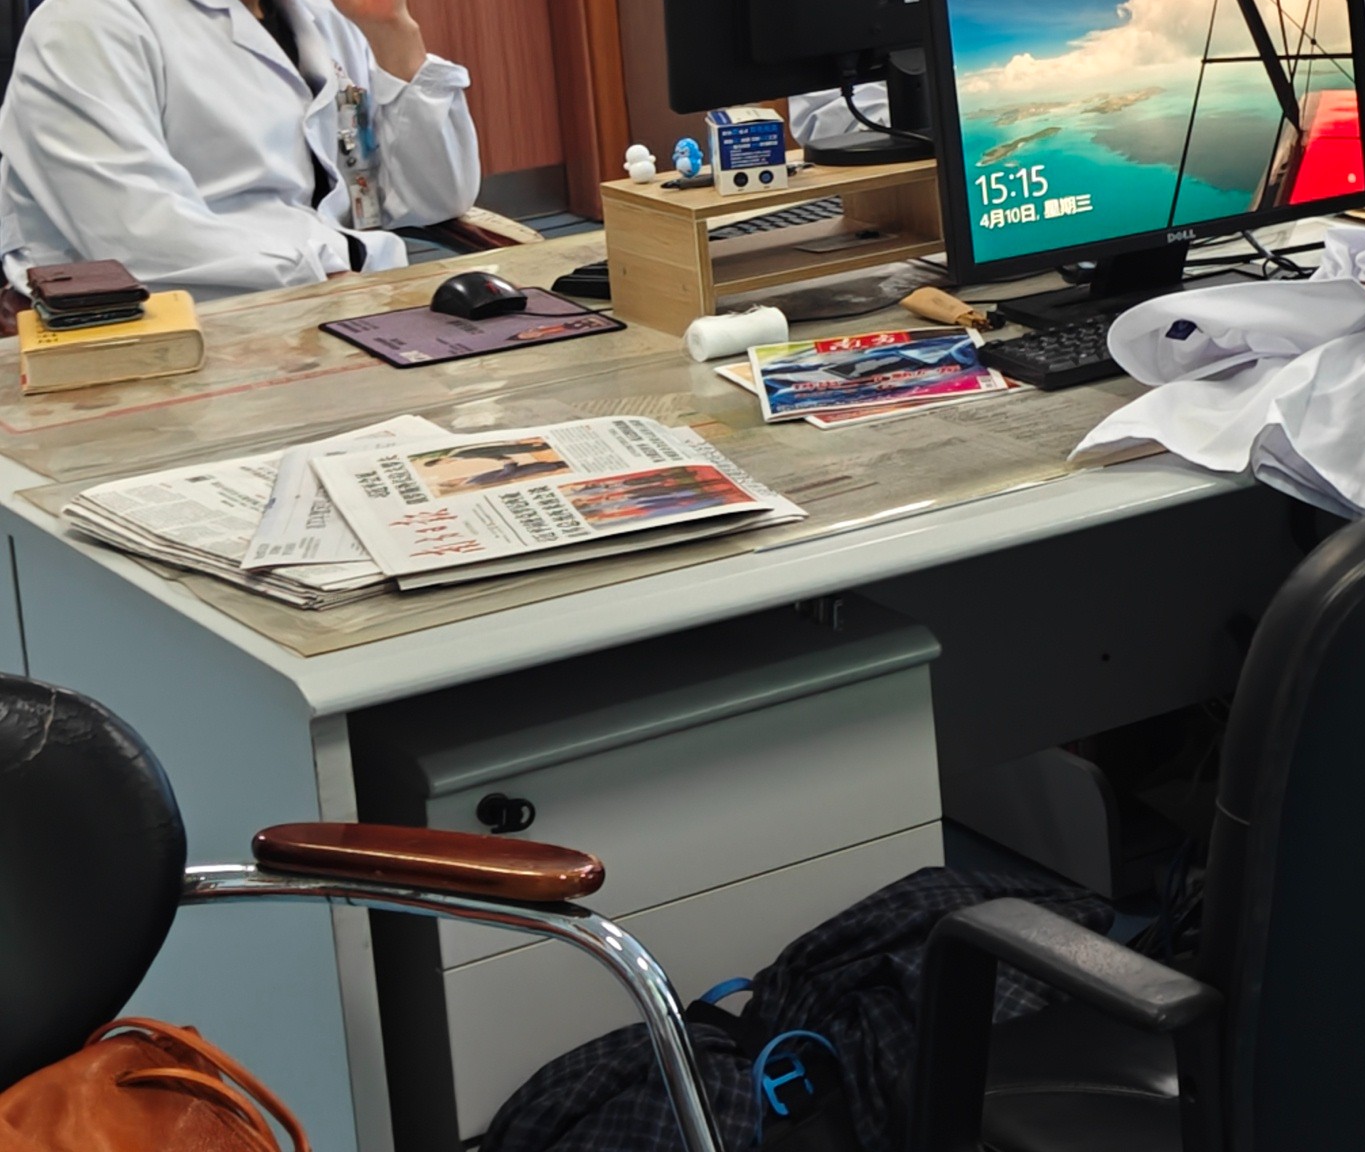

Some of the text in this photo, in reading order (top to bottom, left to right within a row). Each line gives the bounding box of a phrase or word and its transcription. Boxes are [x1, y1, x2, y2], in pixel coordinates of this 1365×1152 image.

[975, 165, 1049, 205] 15:15
[1043, 194, 1094, 219] 星期三
[1167, 228, 1197, 244] DELL
